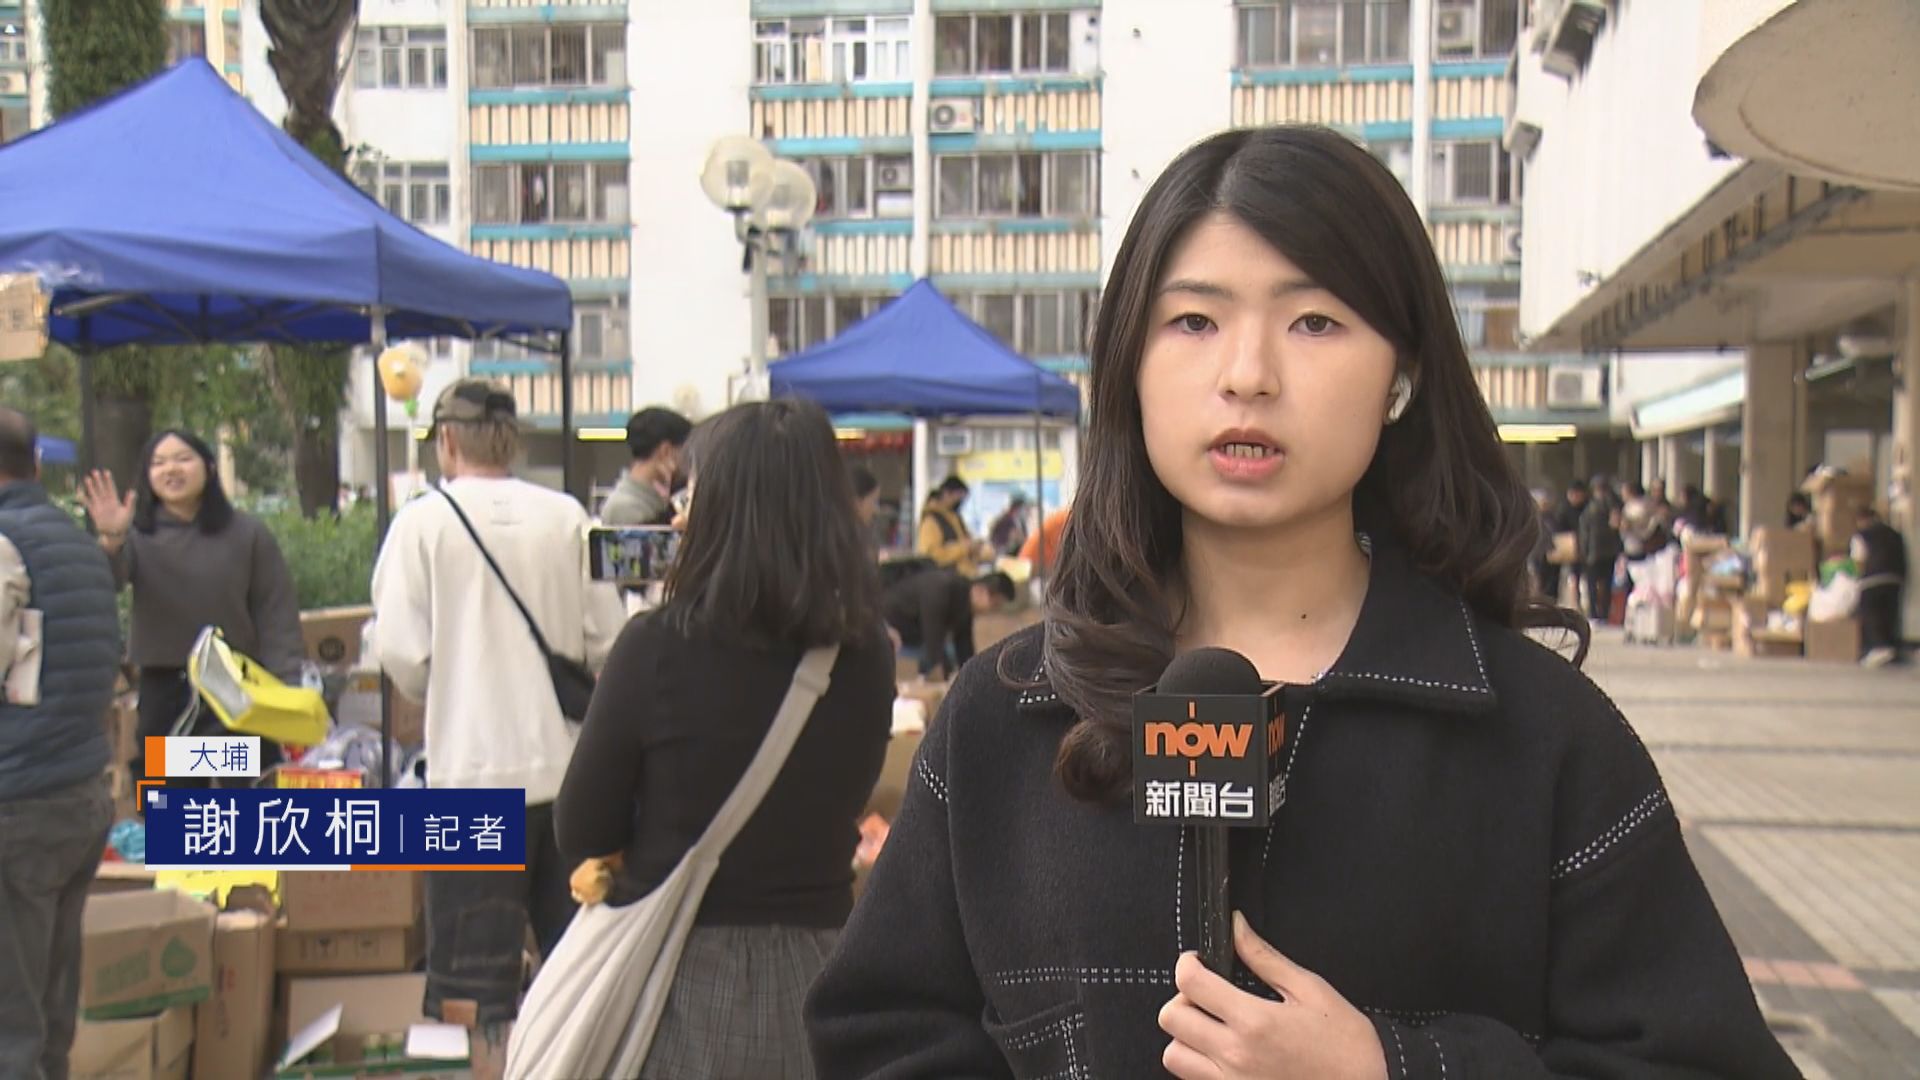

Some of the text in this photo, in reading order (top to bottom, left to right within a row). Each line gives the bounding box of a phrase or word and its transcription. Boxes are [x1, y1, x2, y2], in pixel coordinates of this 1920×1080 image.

[1145, 721, 1254, 758] now
[1145, 780, 1254, 818] 新聞台
